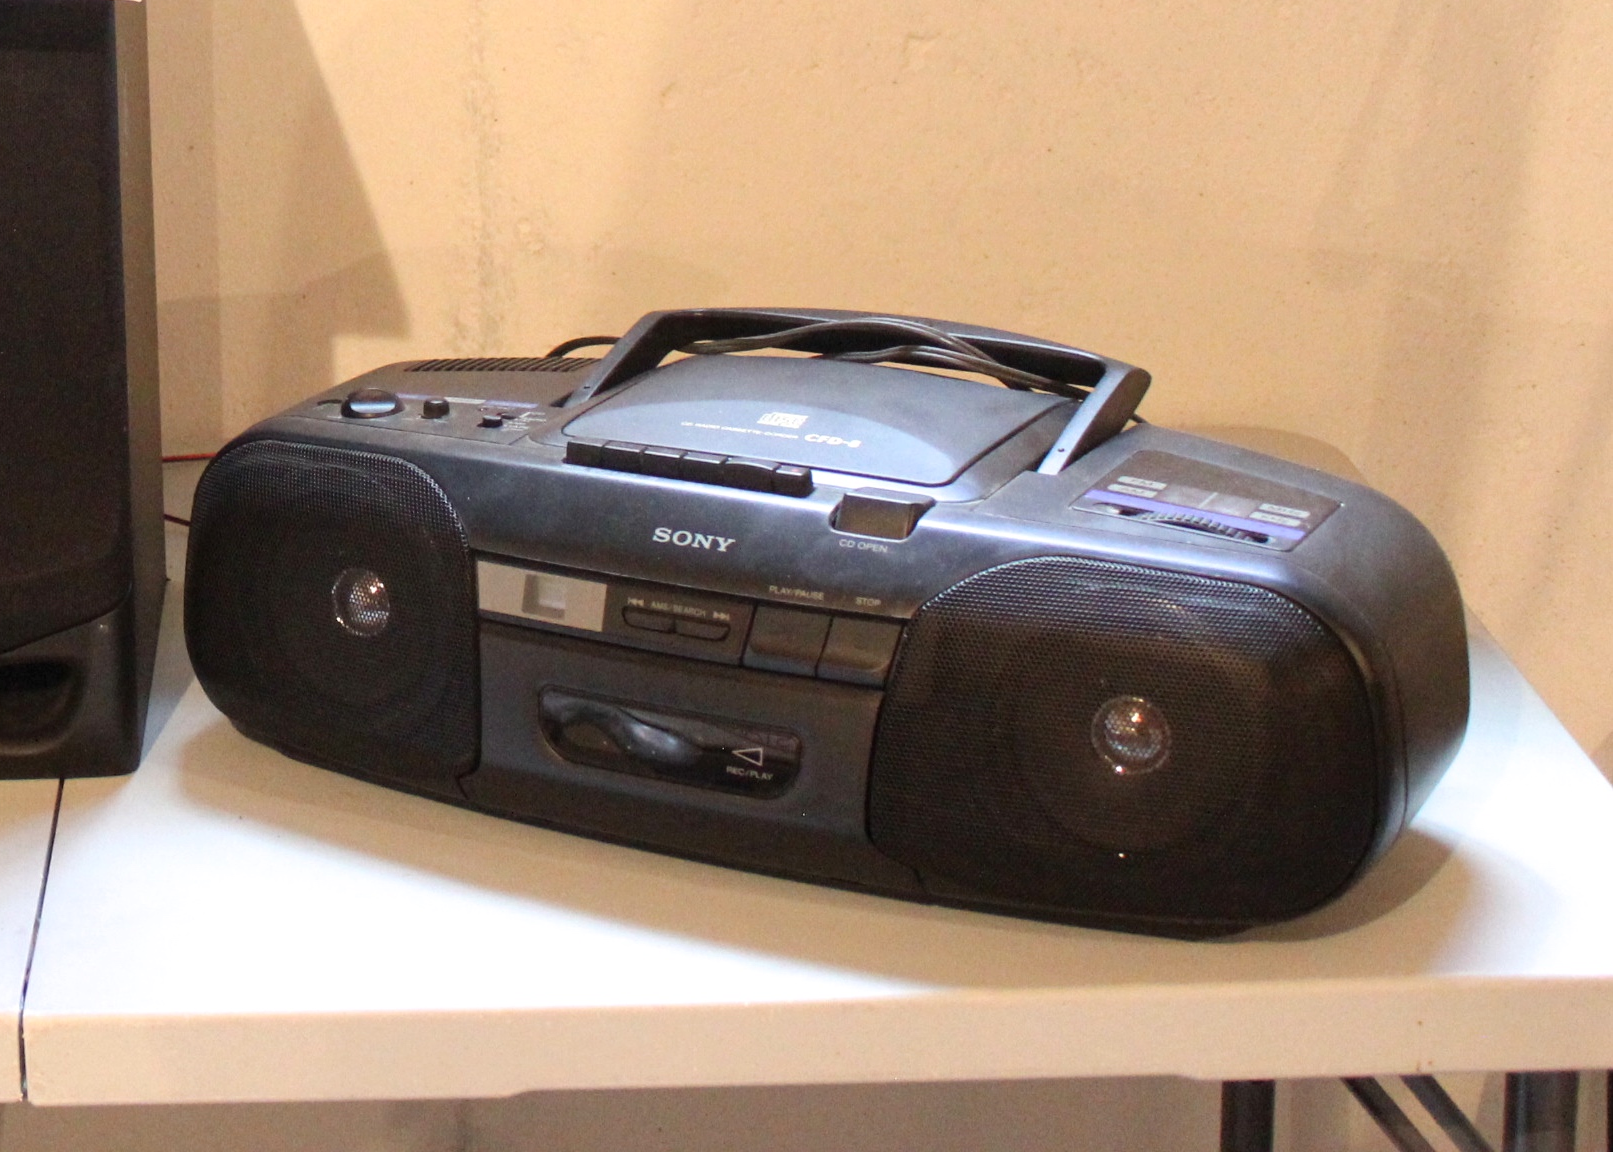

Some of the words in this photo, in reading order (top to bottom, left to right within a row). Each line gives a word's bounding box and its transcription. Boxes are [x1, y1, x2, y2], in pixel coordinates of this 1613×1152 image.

[652, 527, 736, 552] SONY
[839, 538, 855, 548] CD
[857, 540, 888, 553] OPEN
[769, 584, 824, 600] PLAY/PAUSE
[855, 597, 881, 607] STOP
[725, 765, 775, 781] REC/PLAY
